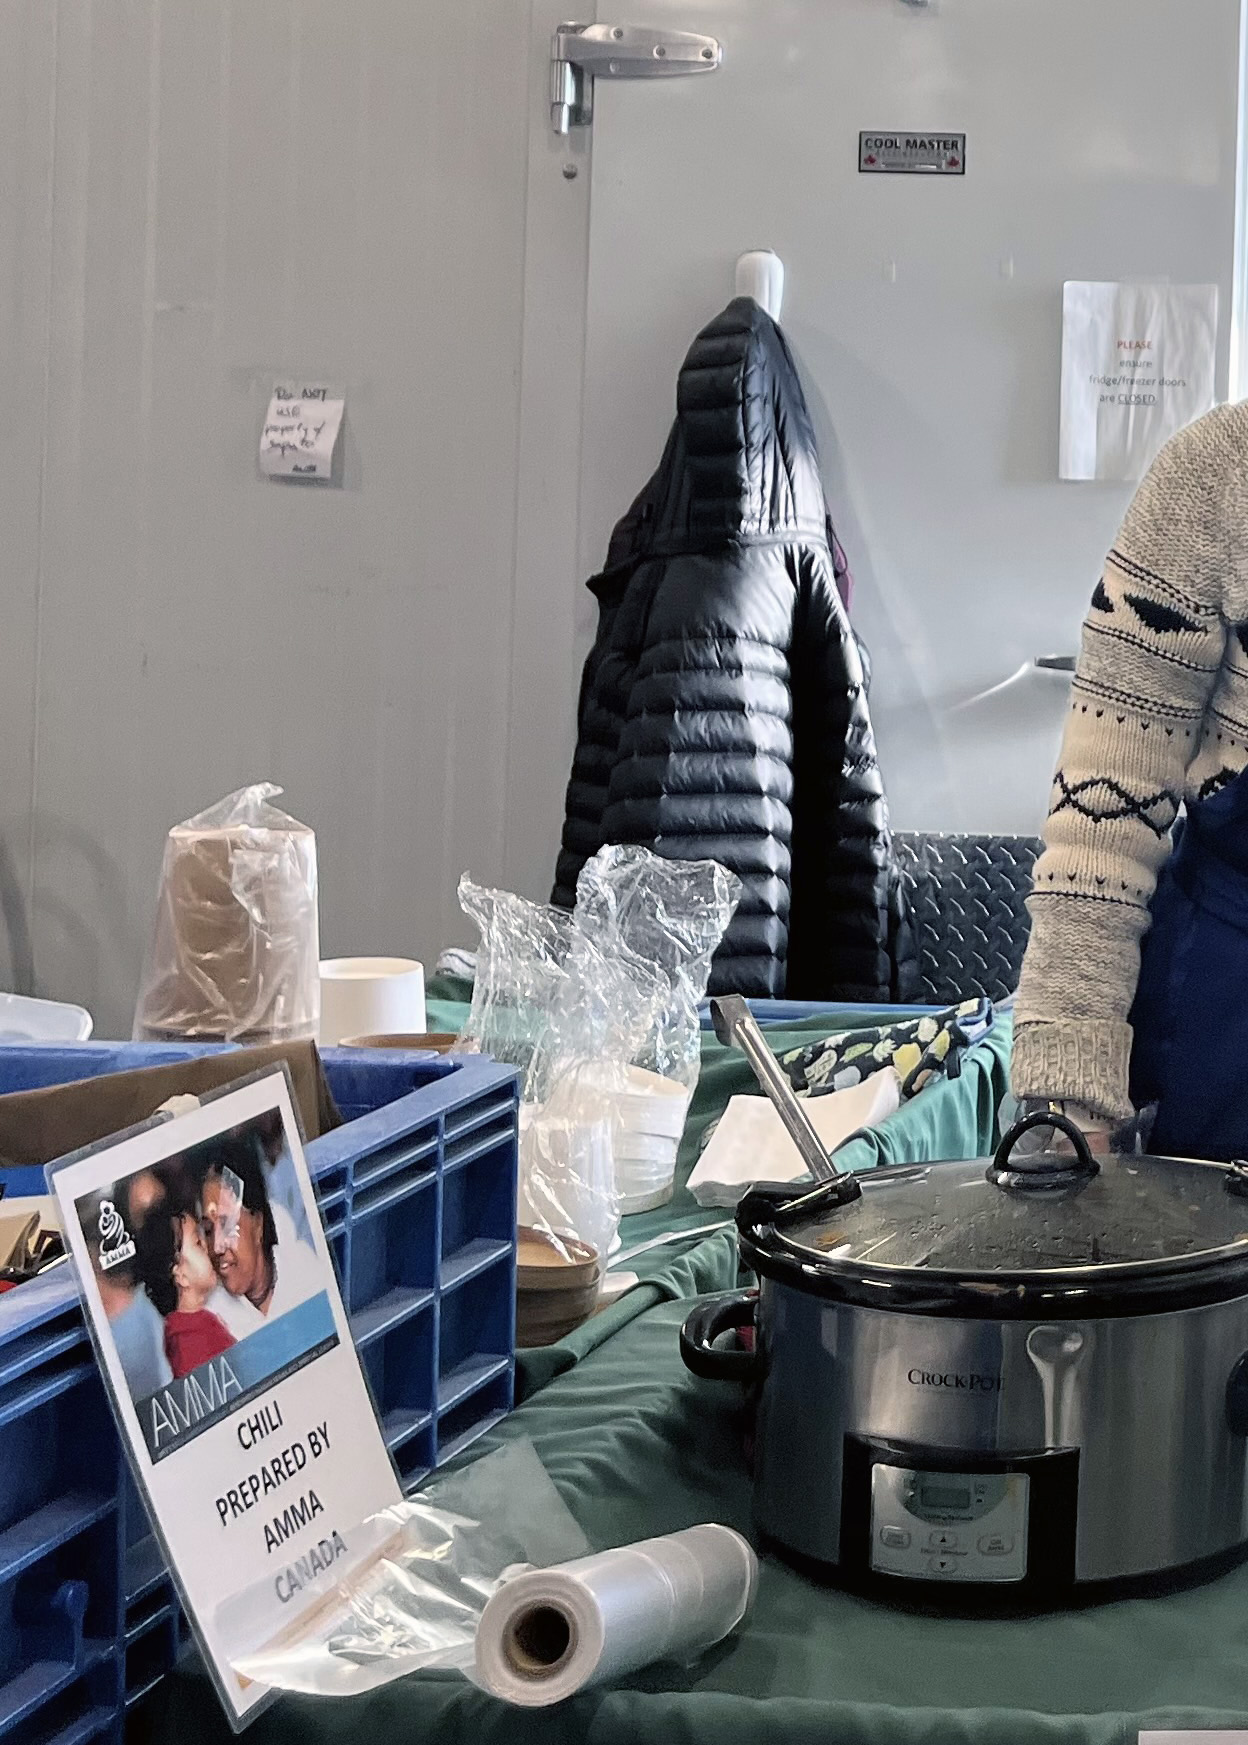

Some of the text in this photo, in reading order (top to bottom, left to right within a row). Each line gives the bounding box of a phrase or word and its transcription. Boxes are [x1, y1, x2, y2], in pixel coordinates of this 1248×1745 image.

[865, 138, 959, 150] COOL MASTER
[1116, 340, 1152, 350] PLEASE
[1119, 359, 1153, 368] ensure
[1089, 375, 1187, 387] fridge/freezer doors
[1099, 394, 1115, 403] are
[105, 1246, 132, 1266] AMMA
[150, 1355, 243, 1447] AMMA
[237, 1400, 284, 1450] CHILI
[215, 1421, 331, 1527] PREPARED BY
[263, 1489, 324, 1554] AMMA
[275, 1530, 348, 1603] CANADA
